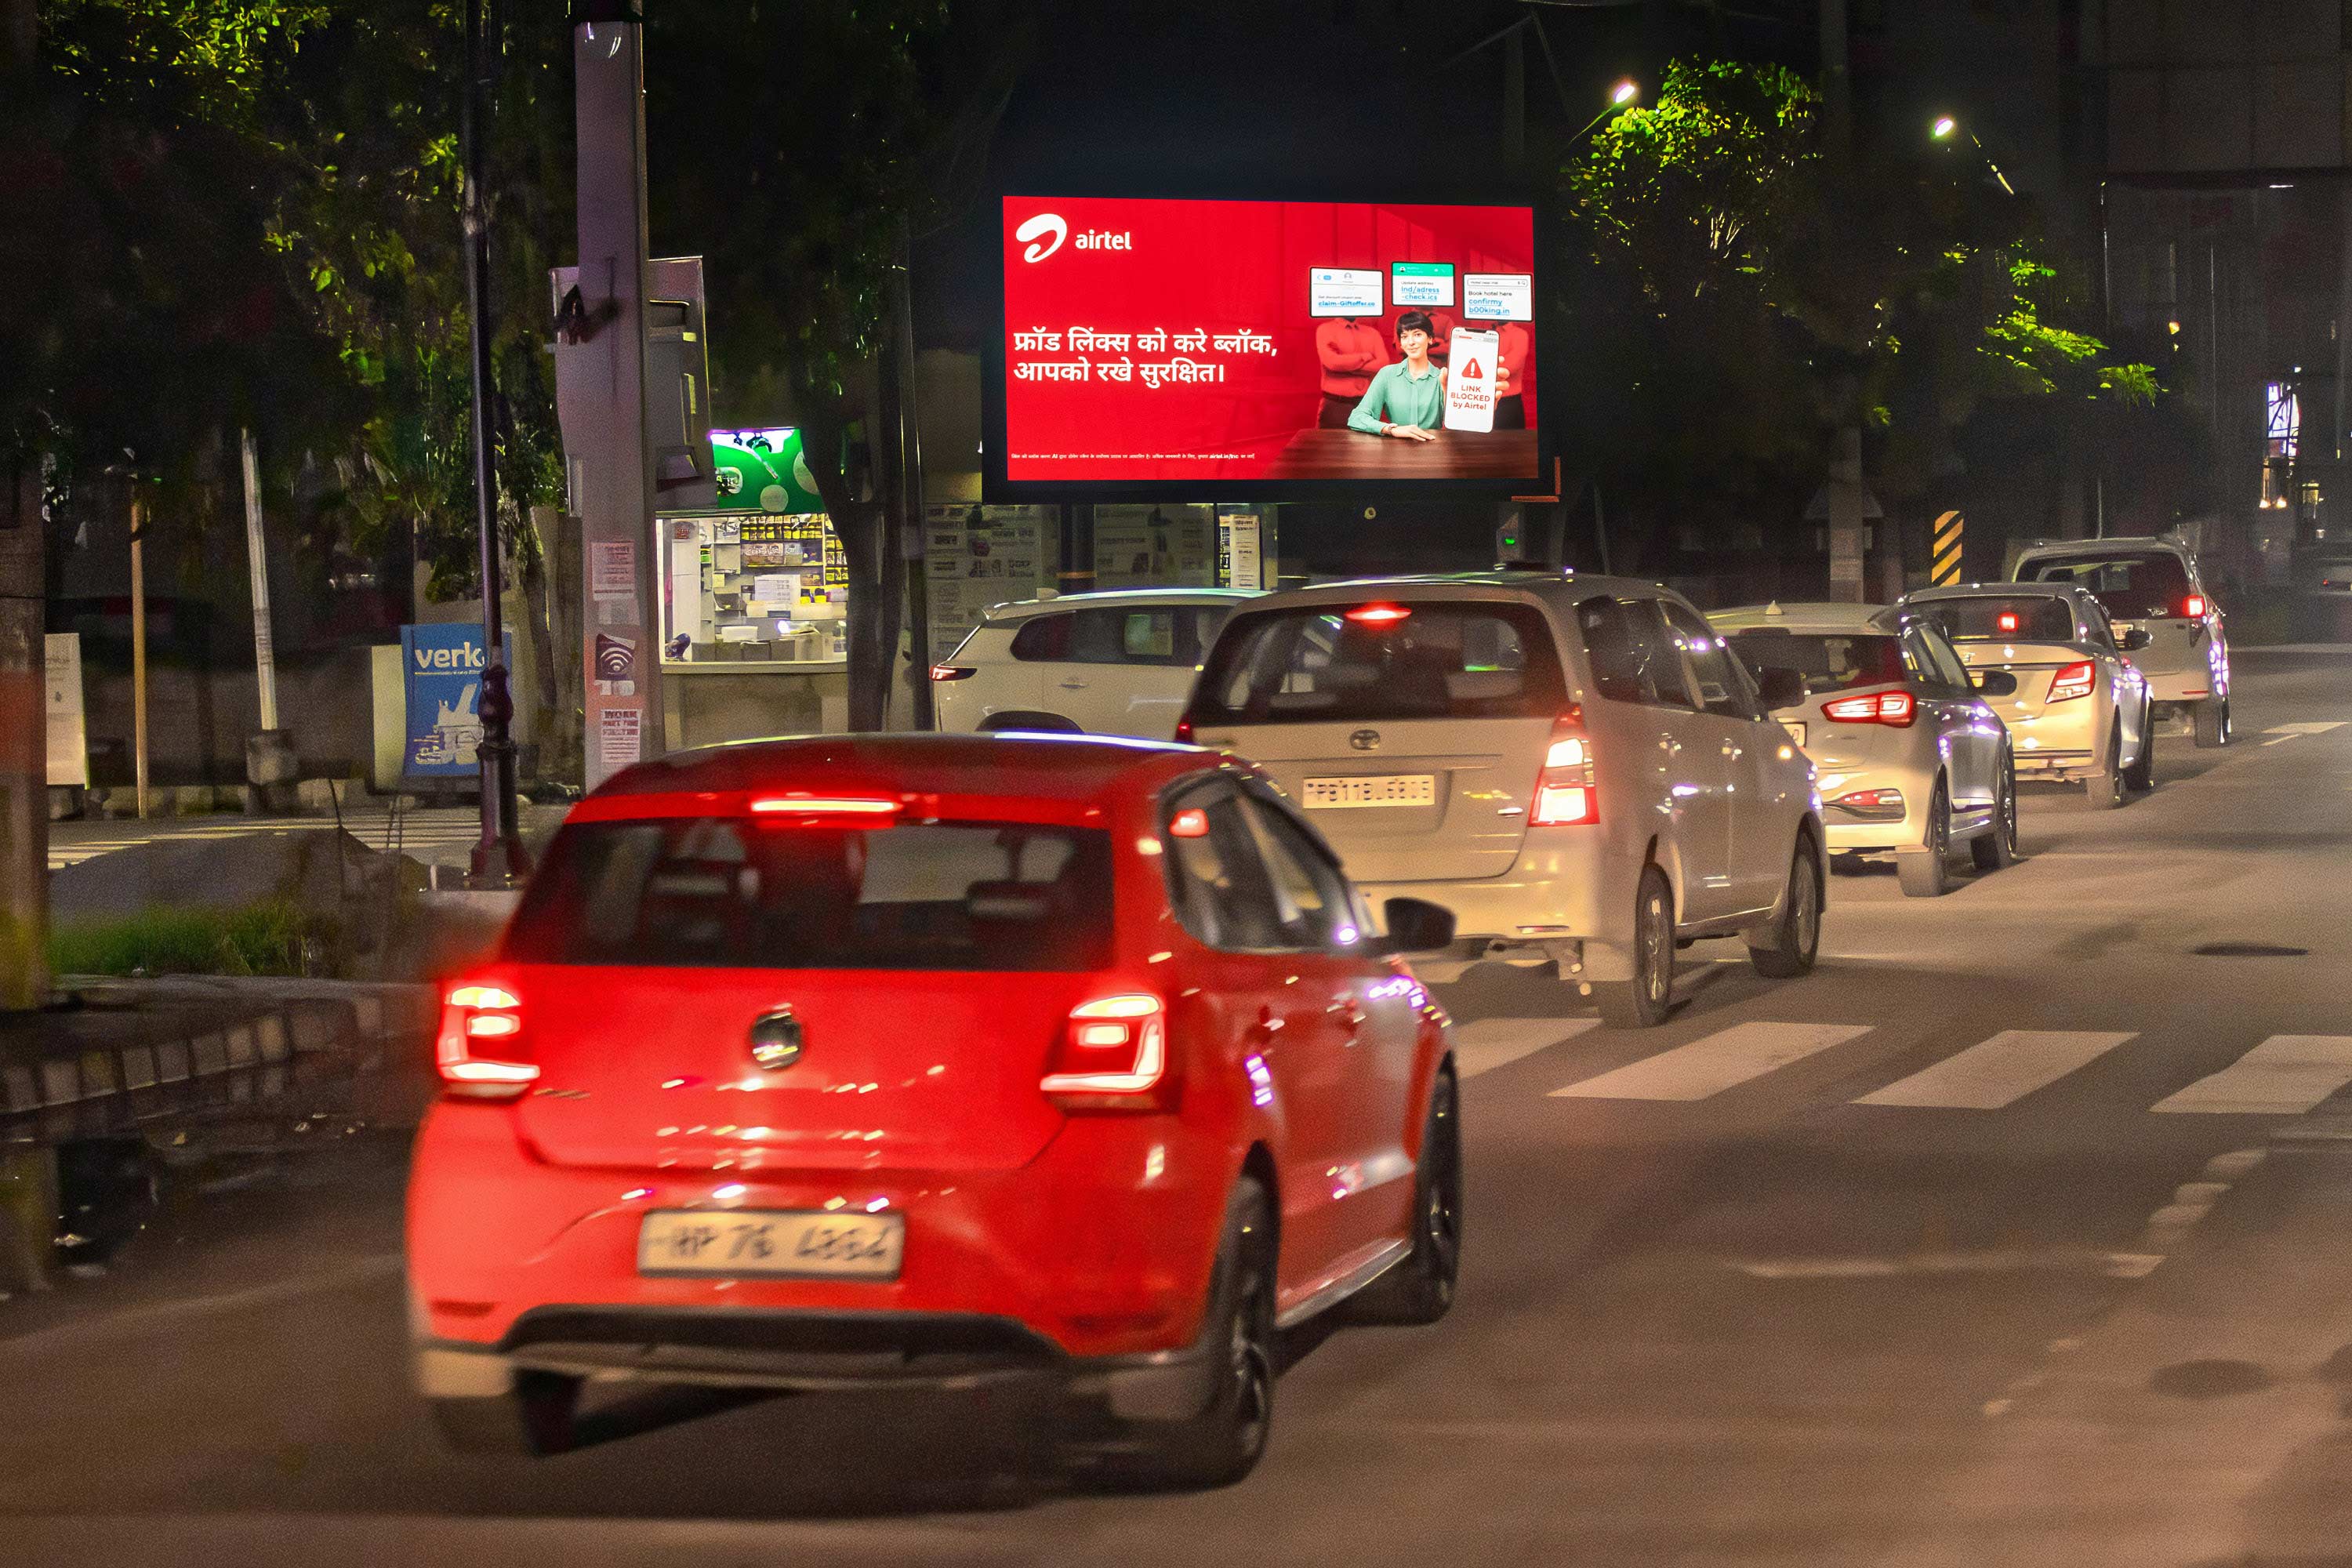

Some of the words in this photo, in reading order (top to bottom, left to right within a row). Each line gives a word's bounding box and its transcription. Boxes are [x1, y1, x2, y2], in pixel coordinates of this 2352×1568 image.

[1075, 229, 1132, 250] airtel
[1013, 326, 1062, 351] फ्रॉड
[1067, 326, 1131, 352] लिंक्स
[1136, 328, 1167, 352] को
[1173, 328, 1207, 353] करे
[1213, 328, 1277, 357] ब्लॉक,
[1013, 356, 1091, 382] आपको
[1096, 357, 1134, 382] रखे
[1450, 392, 1490, 402] BLOCKED
[414, 641, 485, 668] verk
